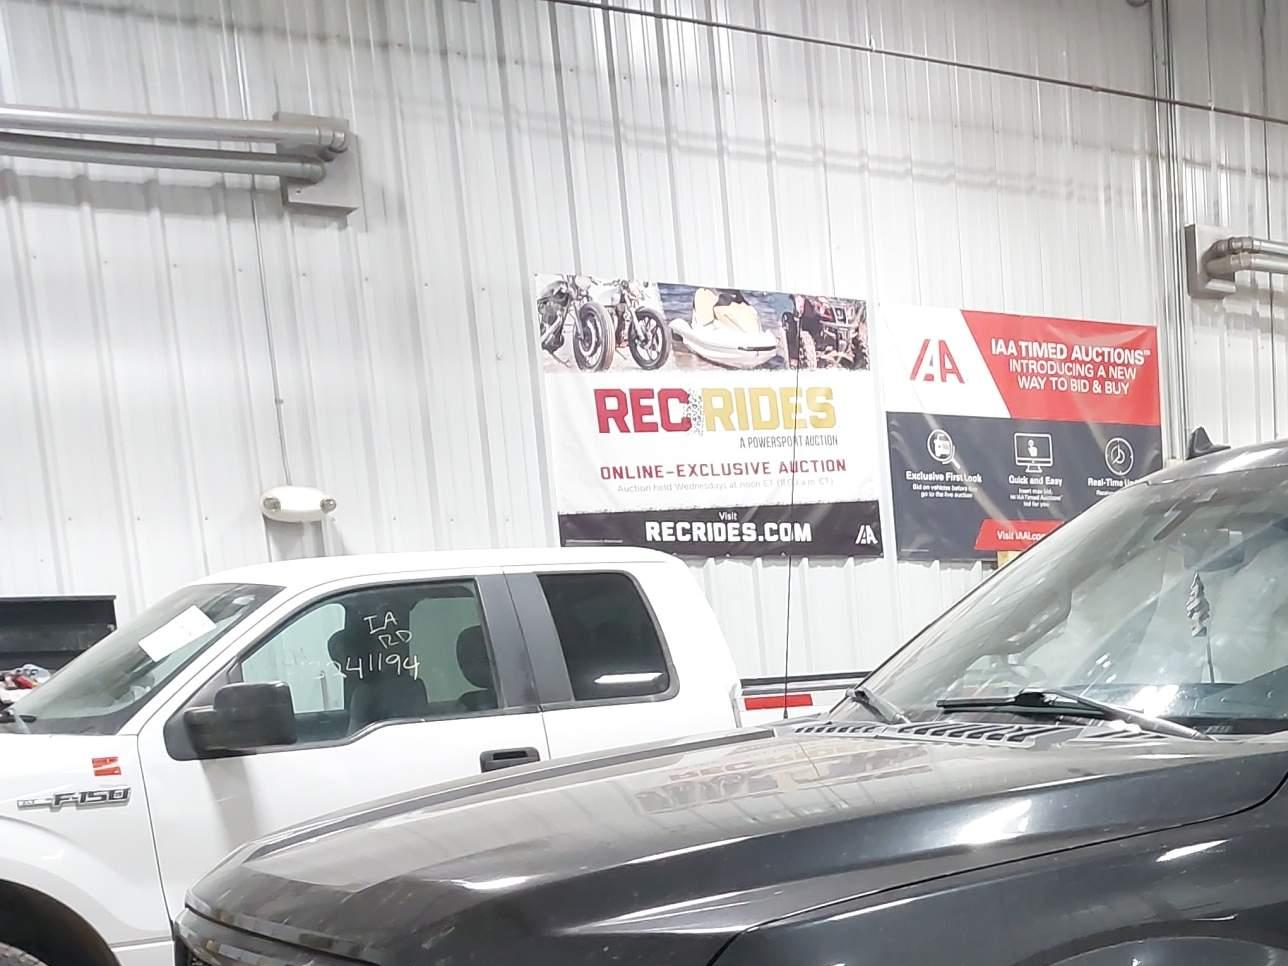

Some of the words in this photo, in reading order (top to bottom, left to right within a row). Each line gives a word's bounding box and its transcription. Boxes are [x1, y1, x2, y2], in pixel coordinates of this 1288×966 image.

[990, 338, 1017, 356] IAA
[1018, 340, 1067, 359] TIMED
[1009, 359, 1094, 378] INTRODUCING
[1097, 367, 1107, 379] A
[1109, 366, 1137, 381] NEW
[1018, 376, 1047, 390] WAY
[1050, 377, 1068, 392] TO
[1071, 380, 1090, 393] BID
[1092, 382, 1102, 394] &
[1105, 381, 1130, 395] BUY
[593, 388, 693, 434] REC
[701, 387, 837, 432] RIDES
[740, 436, 747, 449] A
[748, 434, 803, 449] POWERSPORT
[805, 434, 838, 447] AUCTION
[600, 461, 772, 480] ONLINE-EXCLUSIVE
[779, 459, 847, 473] AUCTION
[905, 470, 944, 481] Exclusive
[945, 472, 963, 482] First
[964, 473, 982, 483] Look
[1008, 474, 1028, 485] Quick
[1029, 476, 1044, 485] and
[1045, 476, 1062, 487] Easy
[1087, 477, 1124, 487] Real-Time
[718, 511, 738, 521] Visit
[645, 521, 812, 542] RECRIDES.COM
[997, 530, 1013, 540] Visit
[53, 787, 131, 807] F-150
